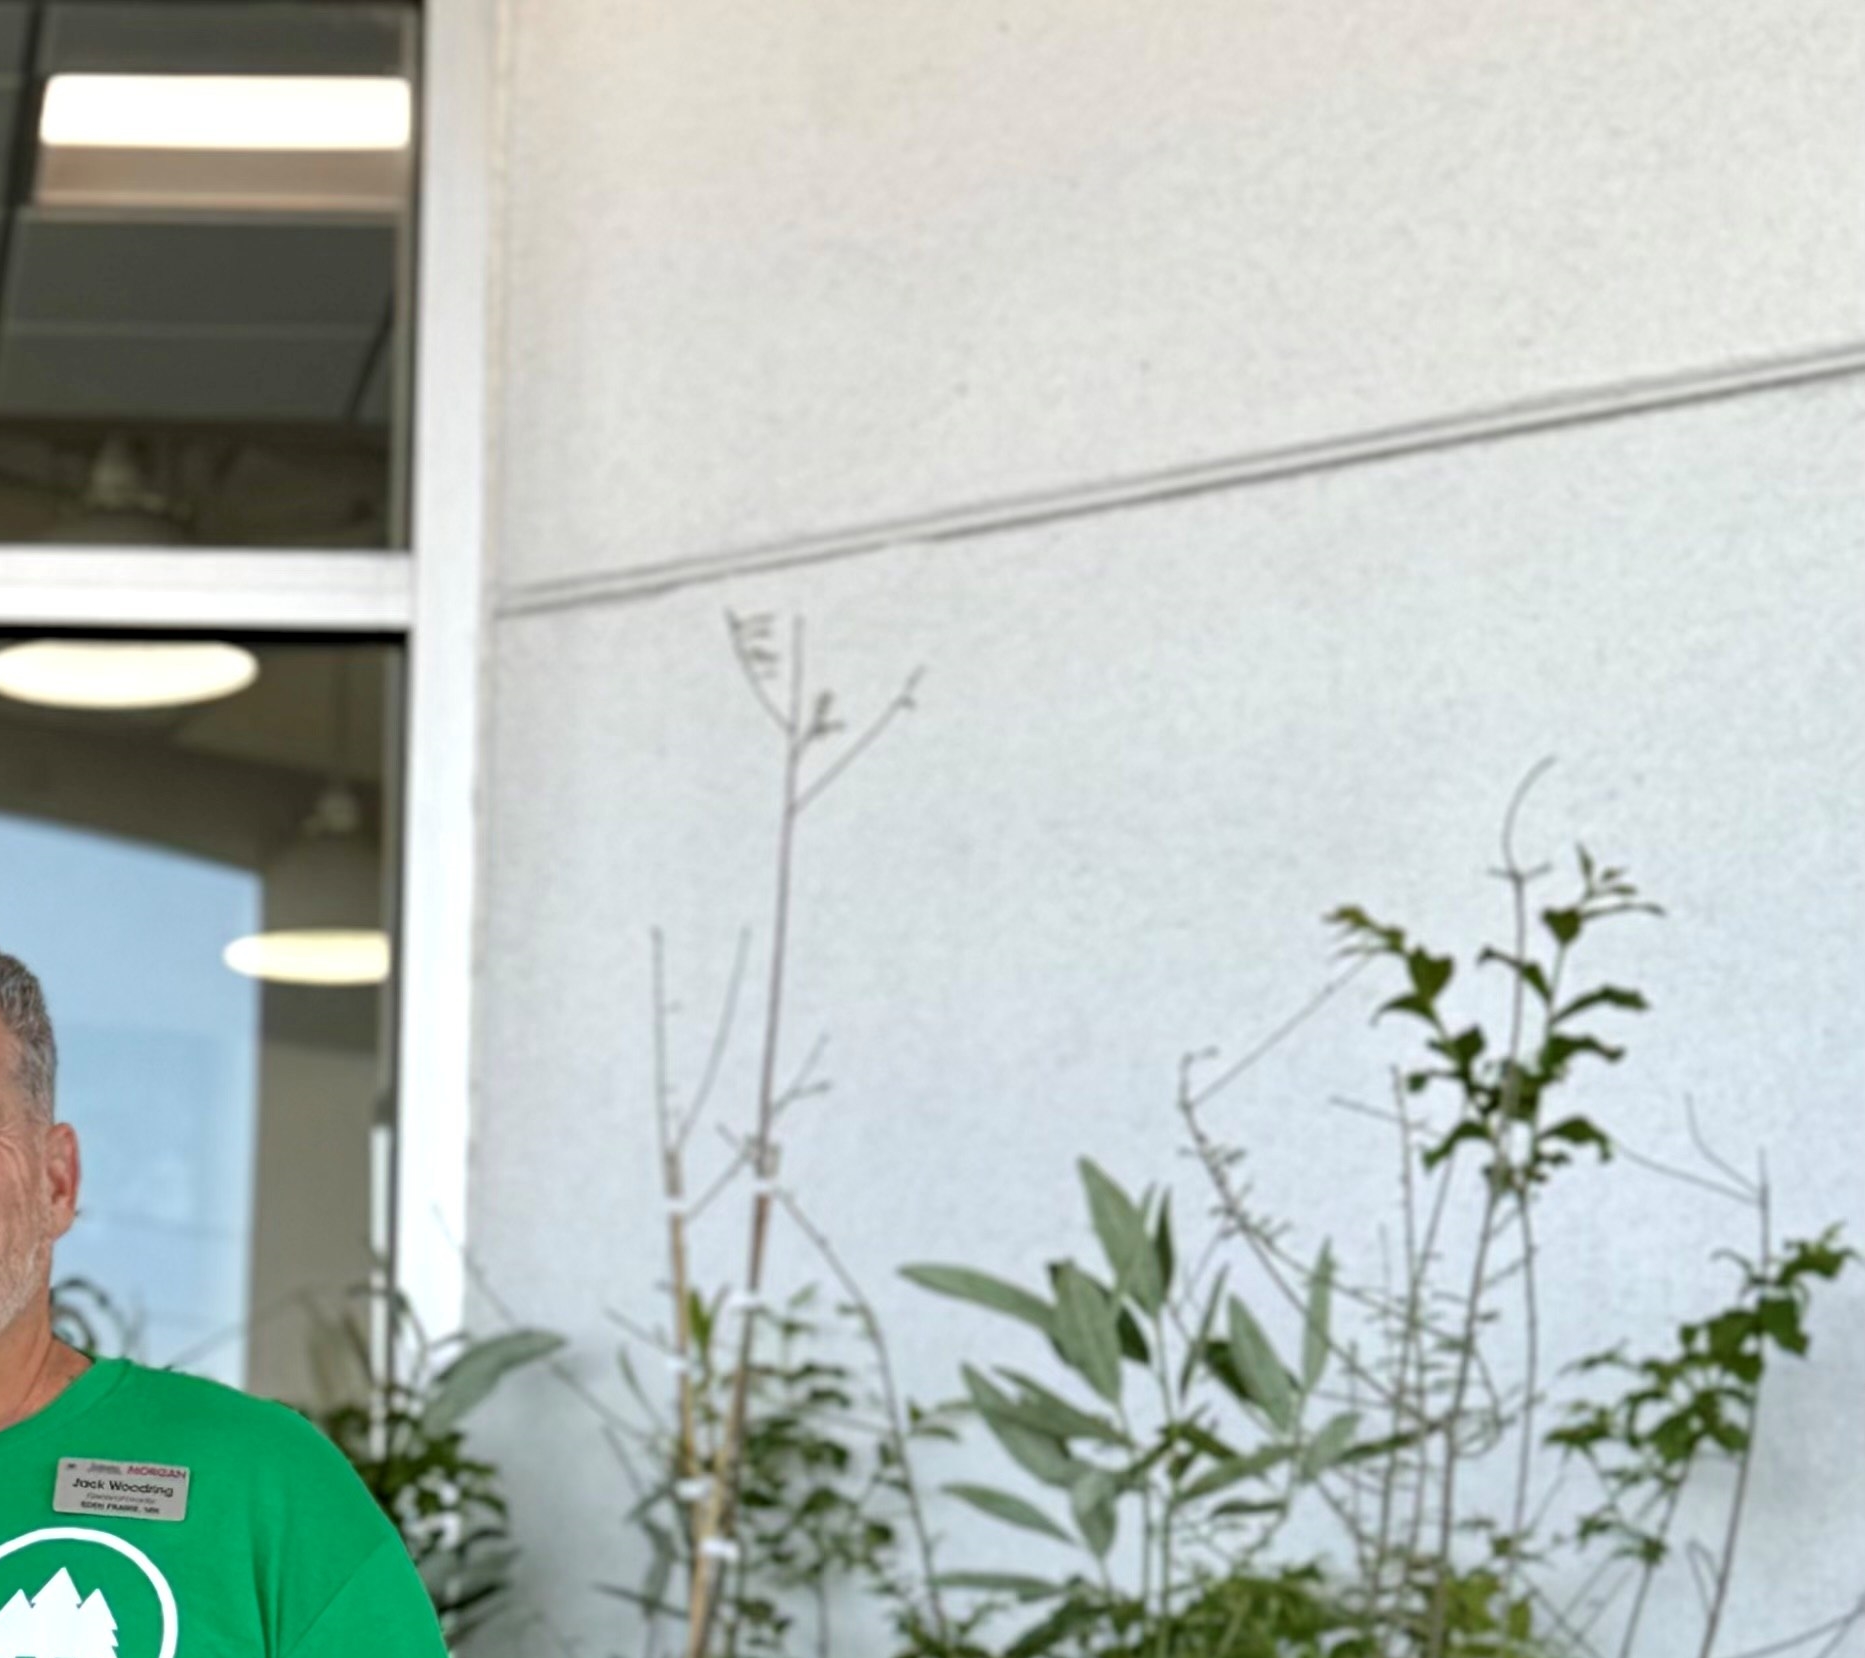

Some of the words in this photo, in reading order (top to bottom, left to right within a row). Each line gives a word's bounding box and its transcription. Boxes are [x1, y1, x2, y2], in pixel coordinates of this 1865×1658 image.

[127, 1466, 187, 1479] MORGAN
[72, 1477, 105, 1490] Jack
[108, 1480, 174, 1498] Woodring
